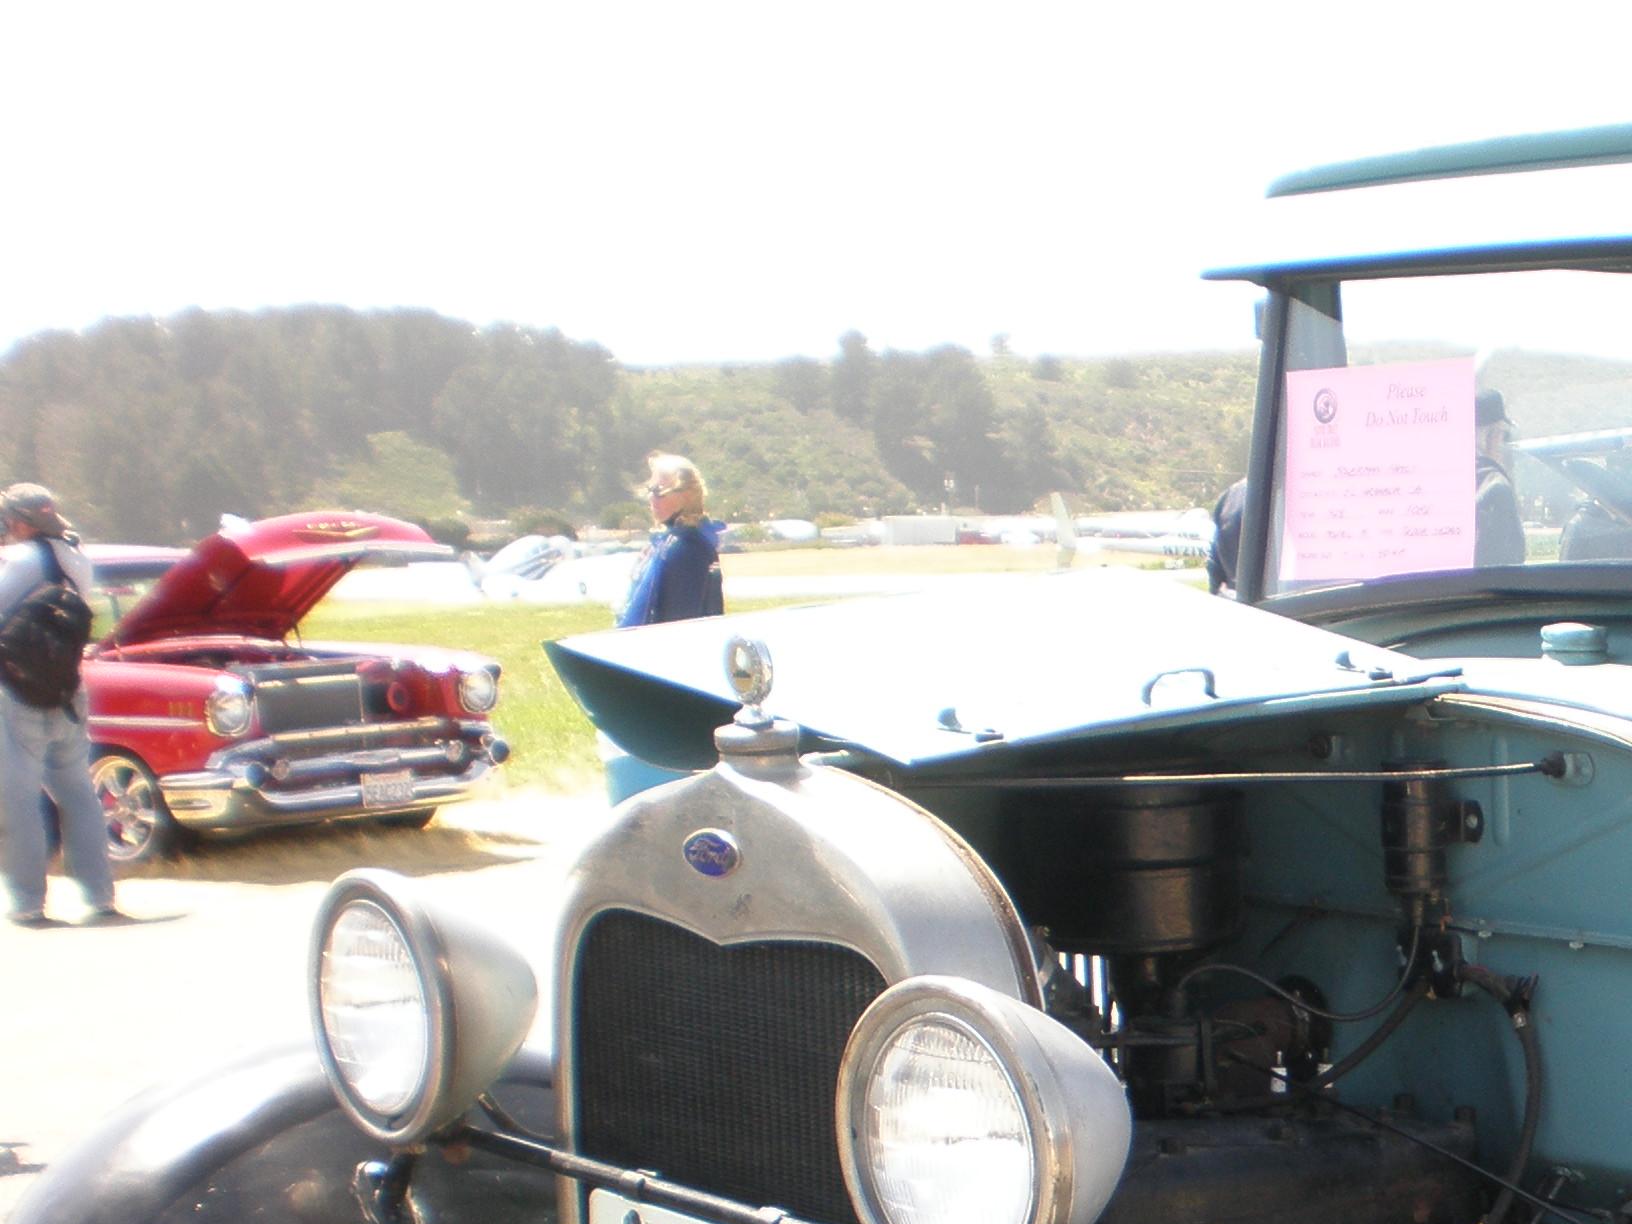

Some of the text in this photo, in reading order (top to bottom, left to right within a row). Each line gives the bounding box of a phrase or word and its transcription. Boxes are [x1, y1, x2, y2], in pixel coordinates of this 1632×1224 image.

[1387, 382, 1427, 400] Please
[1365, 404, 1448, 427] Do Not Touch
